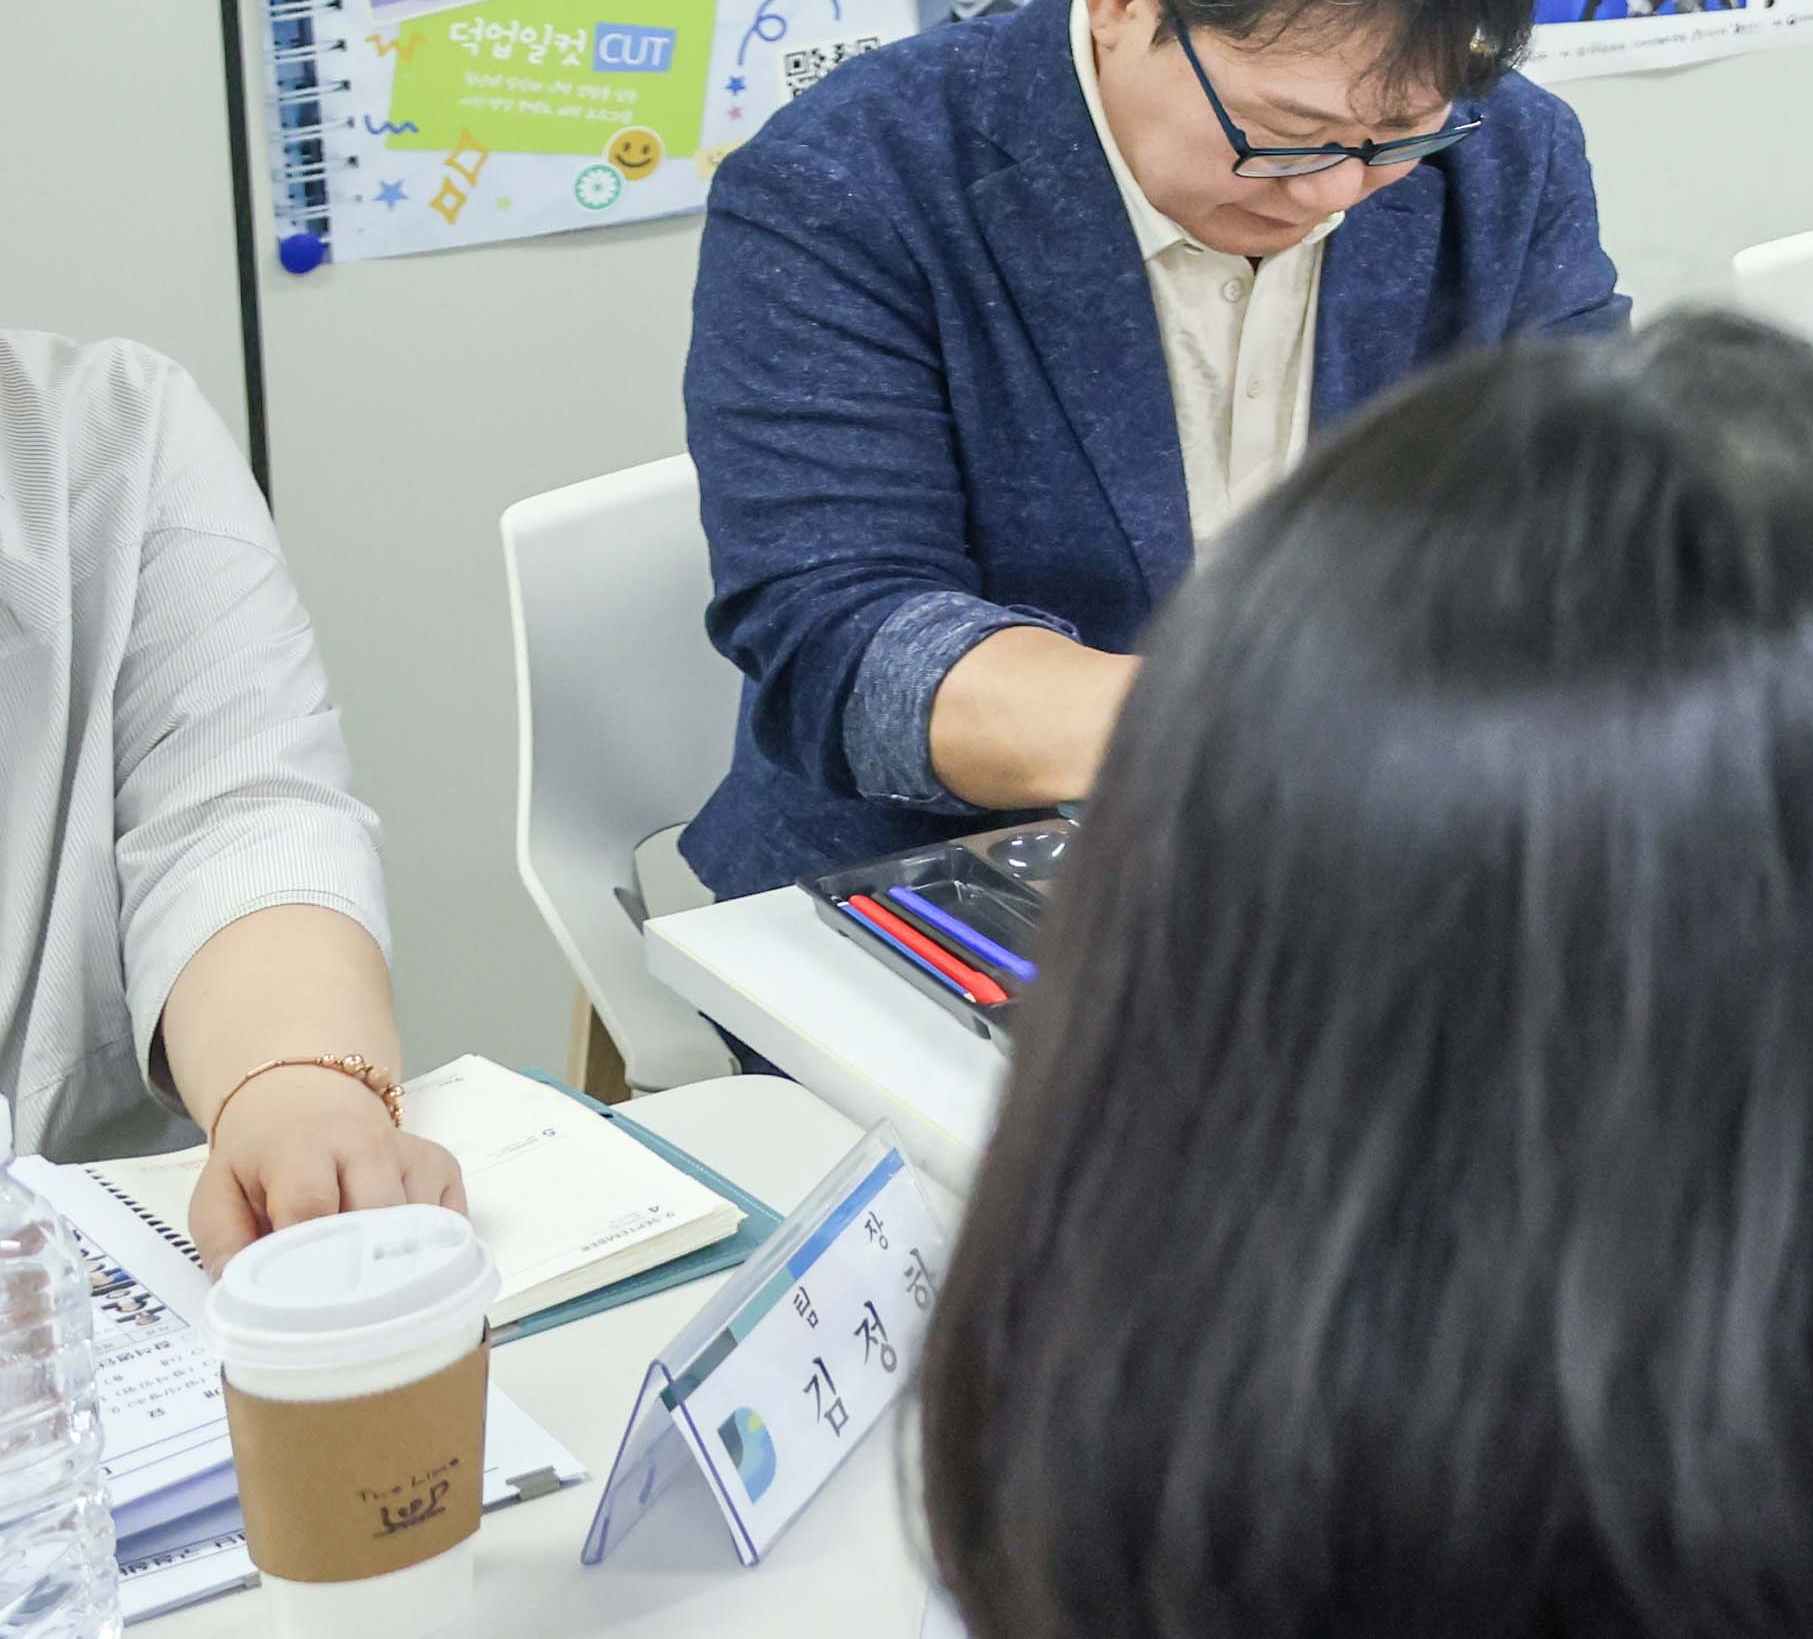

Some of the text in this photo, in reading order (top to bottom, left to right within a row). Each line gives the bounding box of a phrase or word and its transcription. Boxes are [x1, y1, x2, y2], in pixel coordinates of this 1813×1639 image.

[449, 16, 672, 67] 덕업일컷 CUT
[580, 1218, 662, 1253] SEPTEMBER
